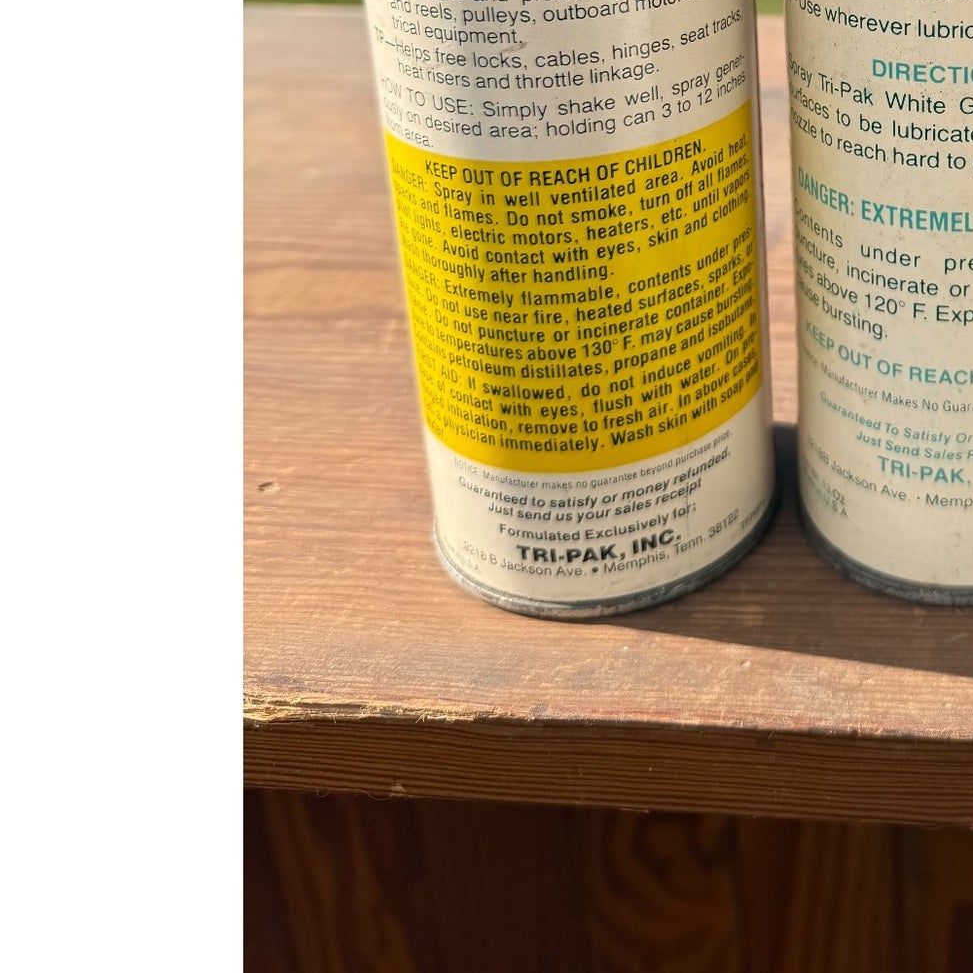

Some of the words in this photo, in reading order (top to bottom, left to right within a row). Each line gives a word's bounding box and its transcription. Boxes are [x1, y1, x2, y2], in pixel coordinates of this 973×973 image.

[825, 6, 911, 35] wherever
[426, 160, 458, 180] KEEP
[463, 168, 494, 185] OUT
[501, 172, 523, 186] OF
[530, 167, 590, 186] REACH
[597, 163, 619, 180] OF
[625, 139, 706, 174] CHILDREN.
[435, 182, 472, 205] Spray
[481, 190, 494, 205] in
[505, 192, 539, 206] well
[551, 182, 635, 207] ventilated
[646, 172, 683, 190] area.
[692, 149, 724, 175] Avoid
[798, 166, 854, 216] DANGER:
[806, 321, 835, 351] KEEP
[838, 345, 872, 369] OUT
[877, 359, 903, 377] OF
[821, 361, 877, 399] Manufacturer
[882, 391, 918, 409] Makes
[923, 399, 938, 411] No
[820, 391, 881, 430] Guaranteed
[885, 423, 899, 436] To
[903, 427, 950, 445] Satisfy
[956, 433, 973, 443] Or
[542, 481, 572, 489] makes
[641, 459, 673, 476] beyond
[676, 442, 711, 466] purchase
[856, 431, 882, 448] Just
[885, 440, 920, 457] Send
[924, 448, 962, 460] Sales
[459, 476, 527, 506] Guaranteed
[532, 497, 545, 507] to
[550, 496, 597, 509] satisfy
[602, 493, 618, 504] or
[622, 477, 670, 500] money
[673, 446, 731, 484] refunded.
[831, 460, 877, 492] Jackson
[878, 455, 971, 486] TRI-PAK,
[488, 502, 513, 516] Just
[518, 509, 551, 520] send
[556, 513, 572, 521] us
[577, 509, 611, 523] your
[614, 499, 652, 515] sales
[655, 478, 702, 504] receipt
[499, 523, 580, 541] Formulated
[586, 512, 669, 539] Exclusively
[517, 543, 625, 563] TRI-PAK,
[632, 528, 682, 554] INC.
[501, 559, 552, 576] Jackson
[556, 566, 587, 576] Ave.
[604, 551, 670, 573] Memphis,
[673, 535, 706, 555] Tenn.
